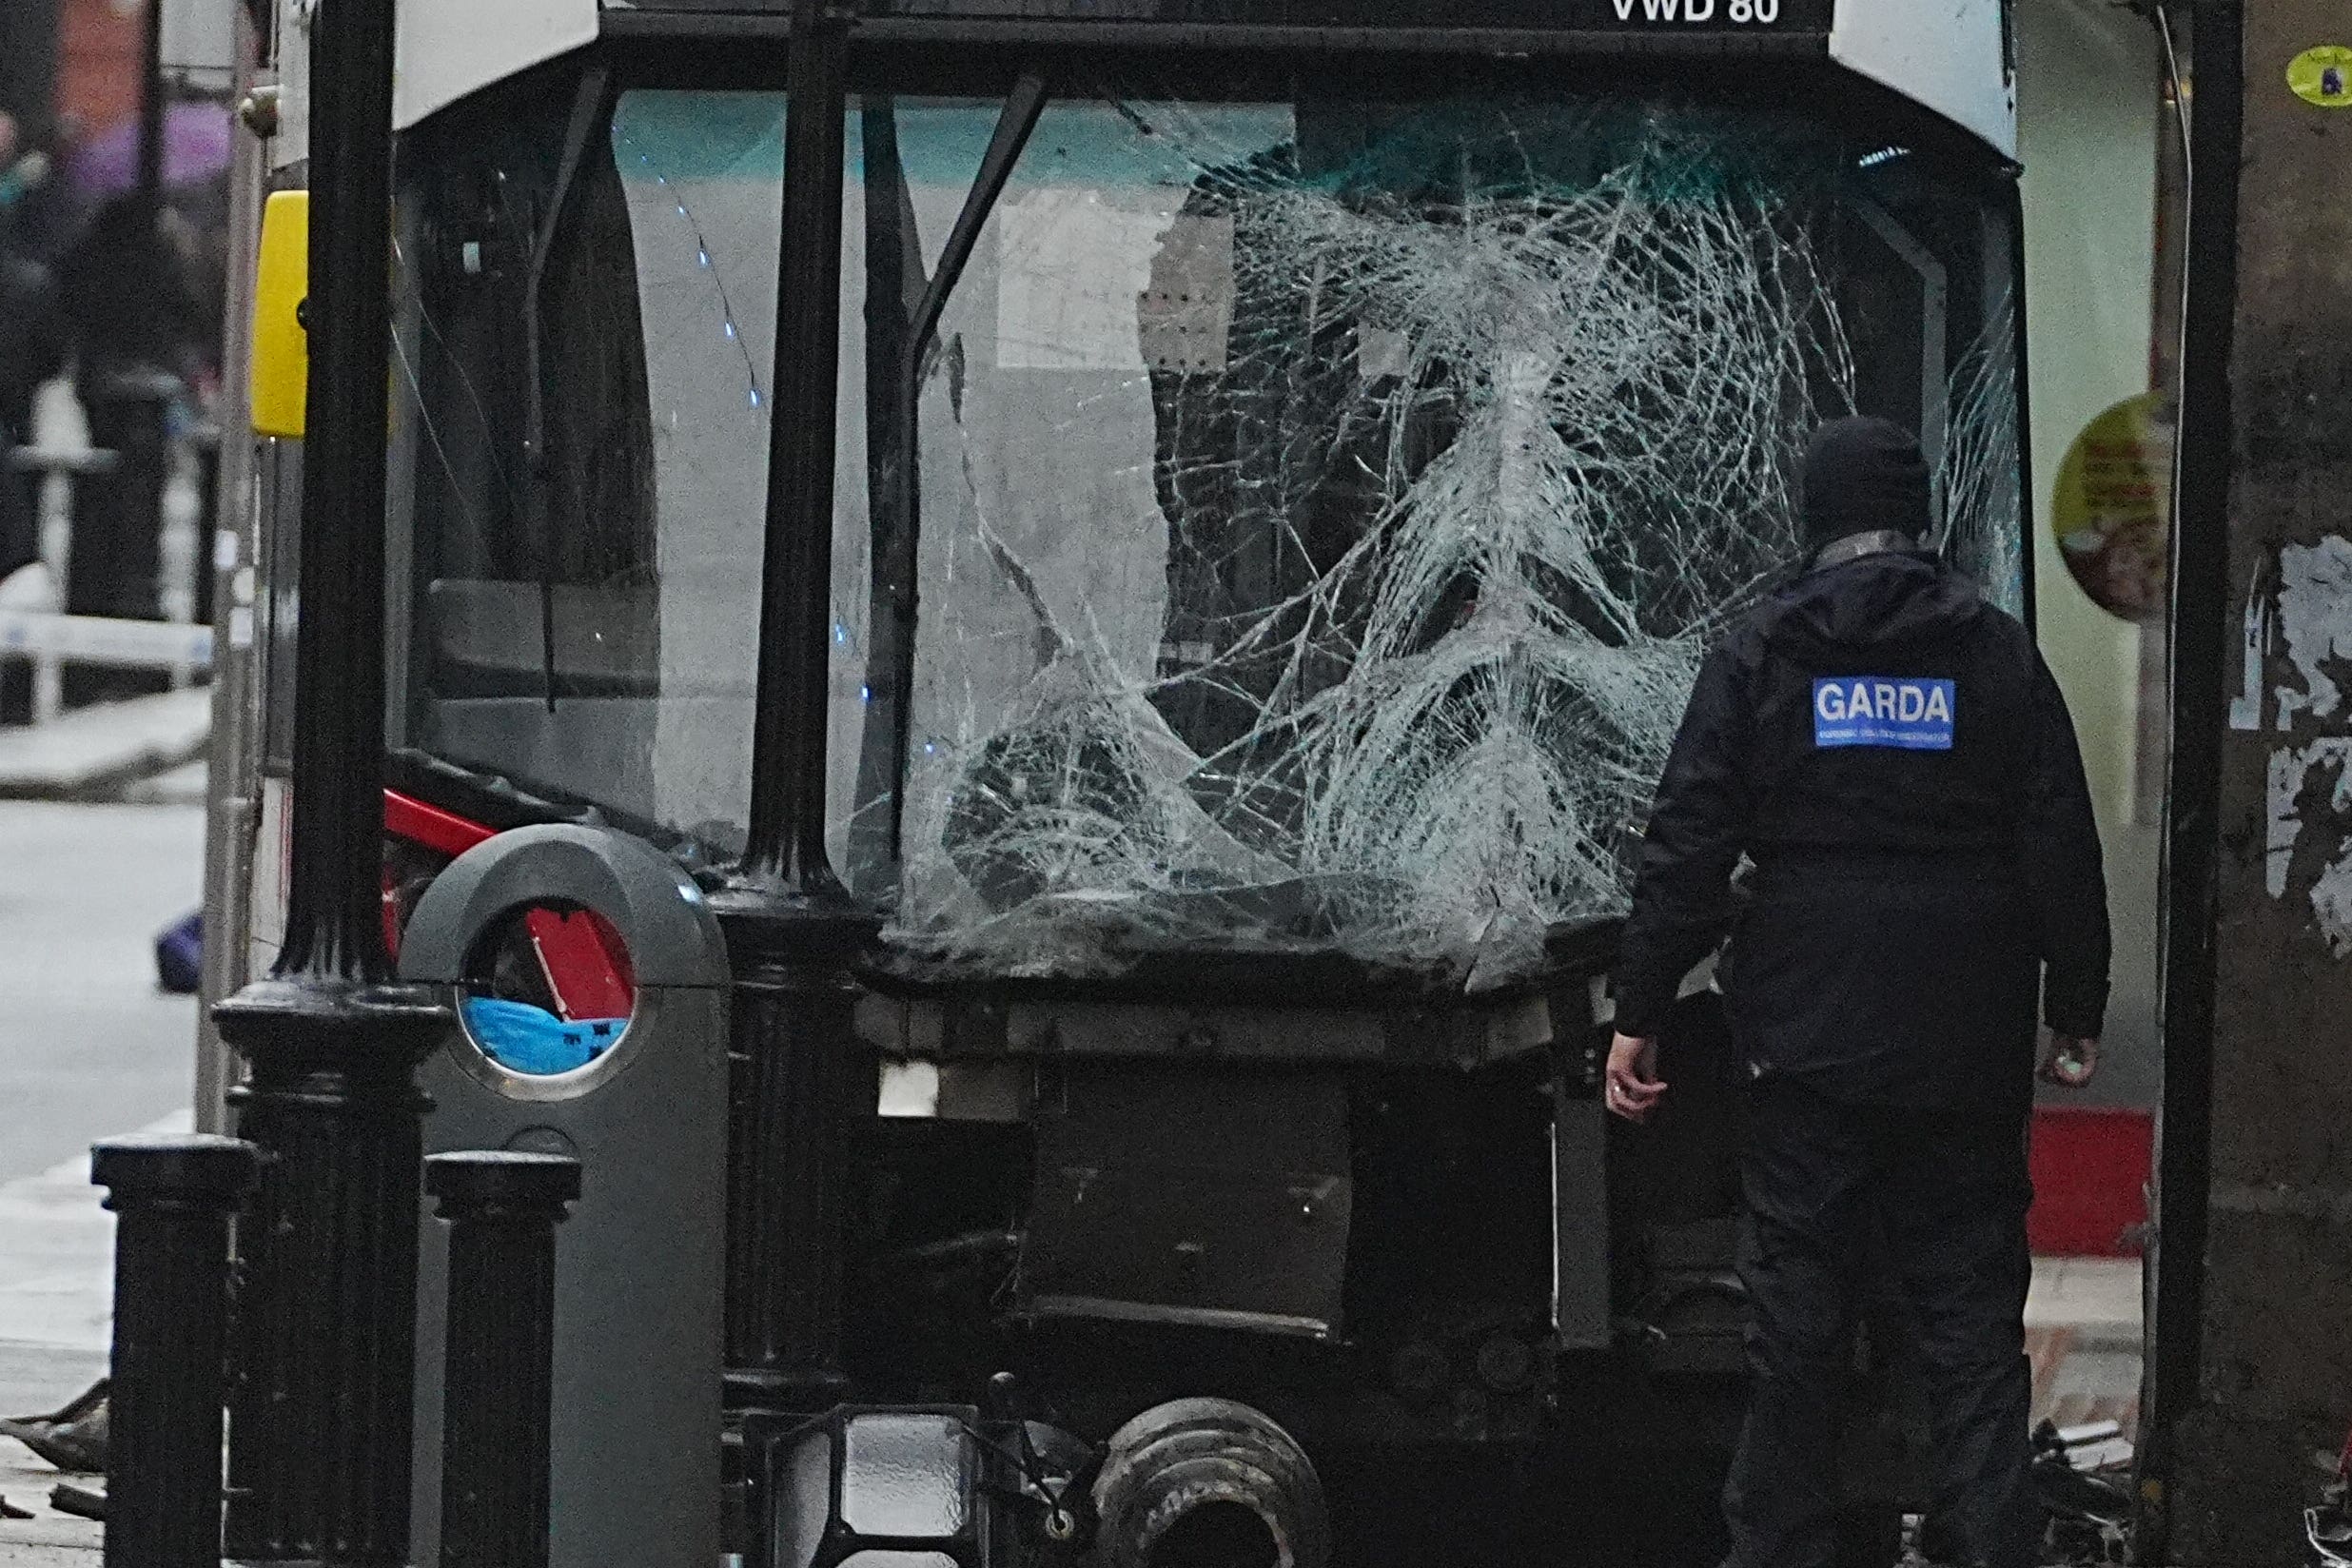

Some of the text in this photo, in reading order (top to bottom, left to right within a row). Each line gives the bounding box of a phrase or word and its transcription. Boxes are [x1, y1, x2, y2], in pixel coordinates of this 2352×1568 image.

[1612, 0, 1779, 23] VWD 80
[1816, 682, 1950, 723] GARDA
